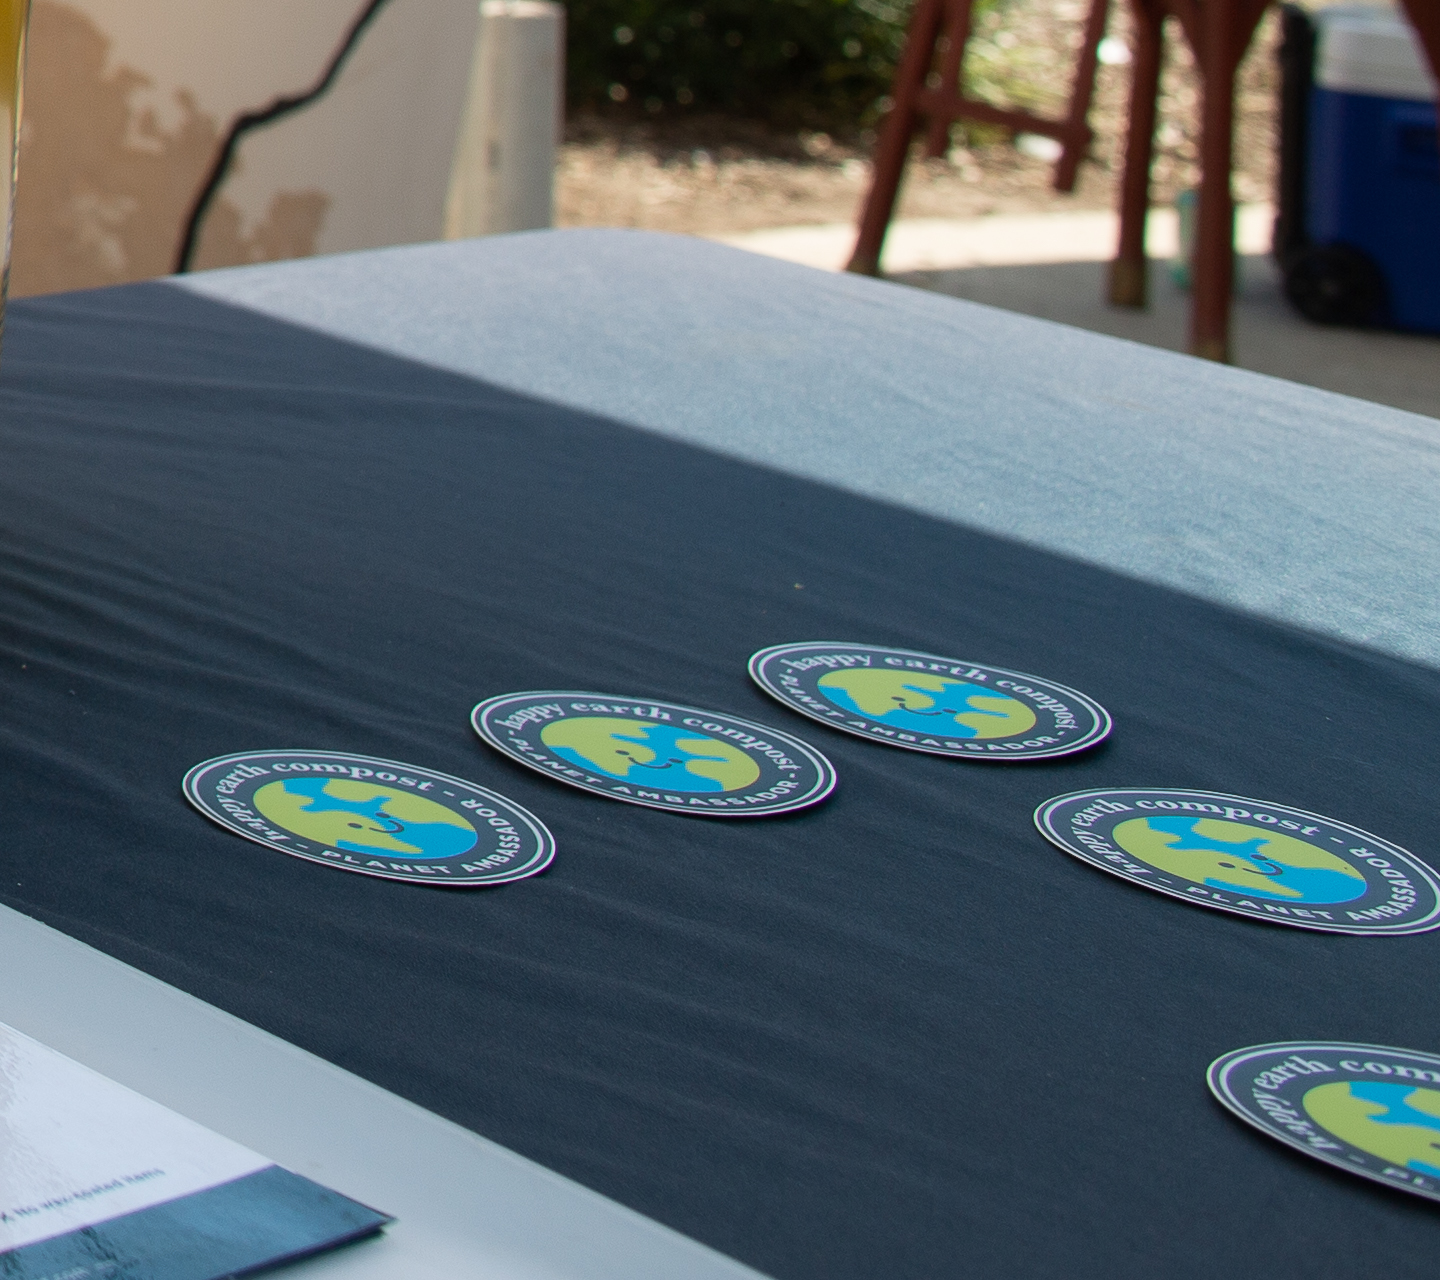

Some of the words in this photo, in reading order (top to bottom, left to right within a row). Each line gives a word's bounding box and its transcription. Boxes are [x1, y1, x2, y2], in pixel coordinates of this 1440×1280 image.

[780, 654, 872, 672] happy
[884, 656, 988, 681] earth
[996, 679, 1079, 731] compost
[494, 702, 566, 731] happy
[570, 702, 671, 721] earth
[683, 716, 804, 772] compost
[215, 762, 271, 794] earth
[272, 761, 435, 791] compost
[508, 737, 603, 784] PLANET
[611, 779, 800, 806] AMBASSADOR
[216, 793, 291, 842] happy
[321, 849, 452, 874] PLANET
[460, 798, 521, 873] AMBASSADOR
[1071, 797, 1132, 827] earth
[1135, 799, 1321, 836] compost
[1071, 826, 1153, 875] happy
[1186, 885, 1334, 922] PLANET
[1346, 846, 1418, 922] AMBASSADOR
[1253, 1054, 1336, 1090] earth
[1339, 1060, 1440, 1084] com
[1252, 1088, 1343, 1150] happy
